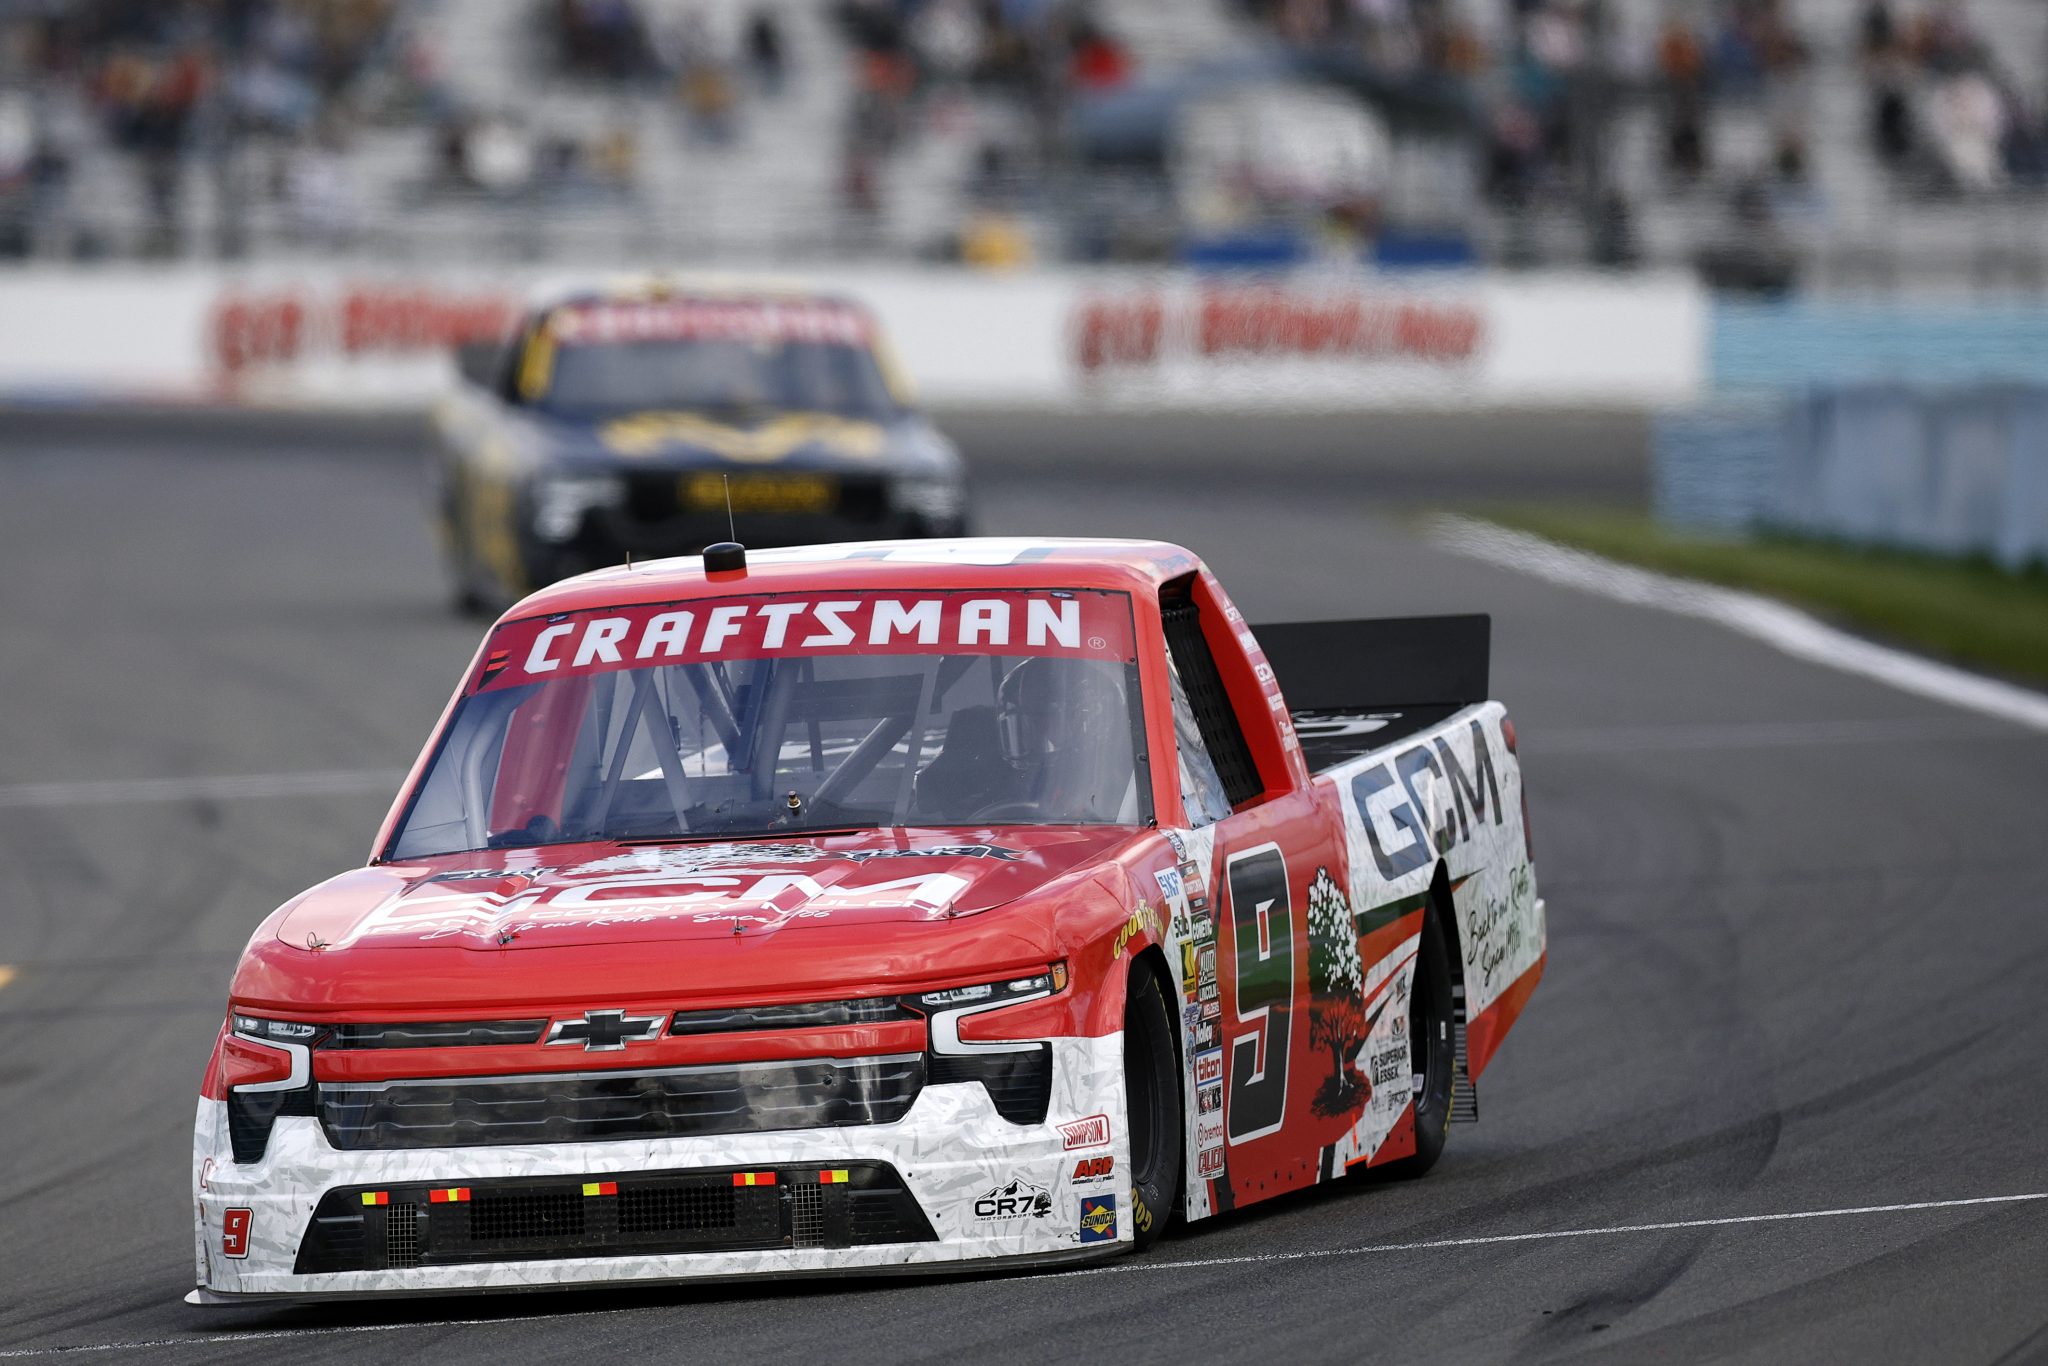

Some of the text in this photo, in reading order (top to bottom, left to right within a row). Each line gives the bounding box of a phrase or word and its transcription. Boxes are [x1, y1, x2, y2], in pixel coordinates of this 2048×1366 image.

[523, 600, 1081, 675] CRAFTSMAN
[1351, 720, 1503, 881] GCM
[1158, 871, 1179, 899] SKF
[528, 901, 746, 919] COUNTY
[586, 914, 658, 928] Roots
[692, 912, 771, 925] Since
[1226, 841, 1293, 1147] 9
[1379, 1044, 1408, 1067] SUPERIOR
[1198, 1057, 1221, 1081] tilton
[1380, 1065, 1399, 1083] ESSEX
[1063, 1119, 1104, 1147] SIMPSON
[1204, 1123, 1222, 1142] brembo
[1072, 1155, 1115, 1179] ARP
[1199, 1146, 1224, 1174] CALICO
[974, 1195, 1035, 1217] CR7
[1082, 1210, 1116, 1228] SUNOCO
[224, 1207, 254, 1259] 9
